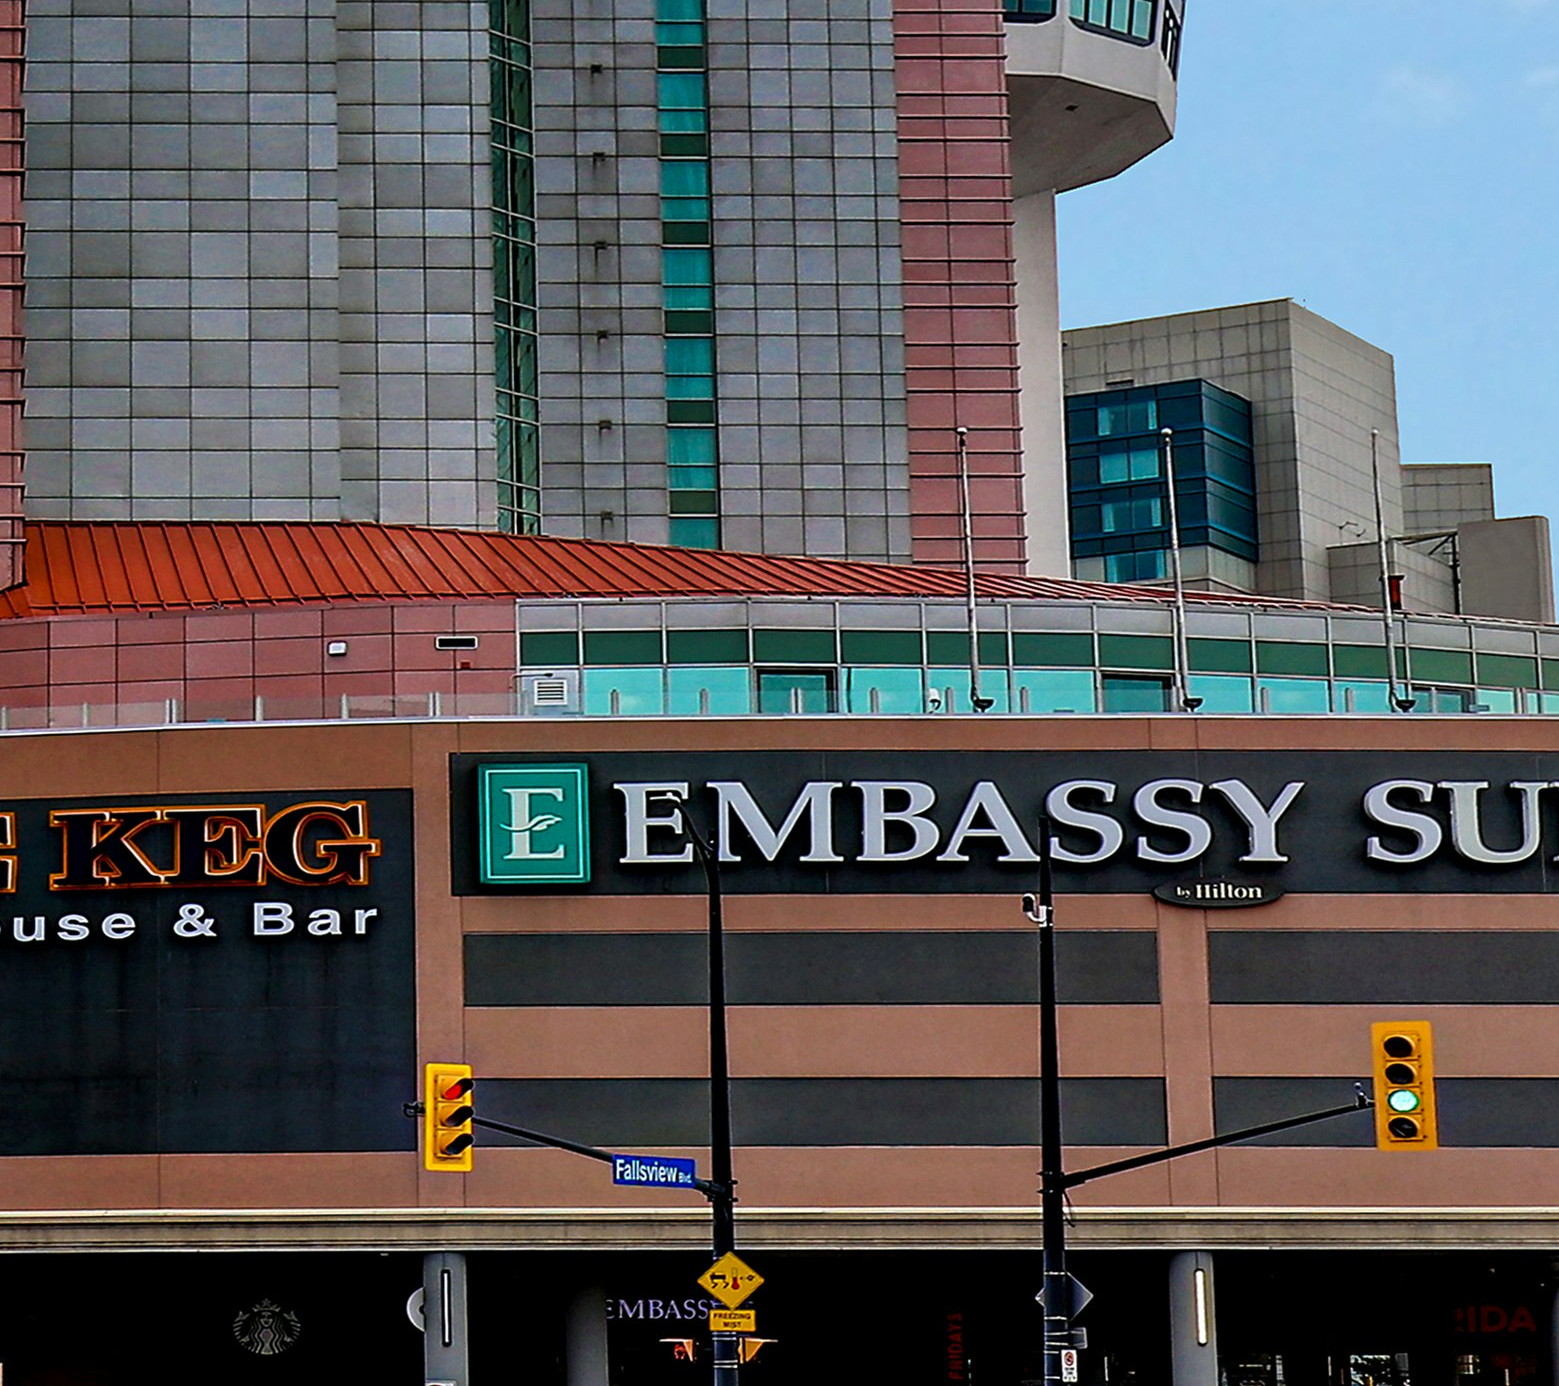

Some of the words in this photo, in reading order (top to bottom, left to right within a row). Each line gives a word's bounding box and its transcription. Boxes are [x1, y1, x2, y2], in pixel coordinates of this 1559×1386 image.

[613, 778, 1306, 864] EMBASSY
[48, 800, 381, 892] KEG
[1176, 886, 1191, 899] by
[1196, 882, 1263, 899] Hilton
[172, 903, 217, 938] &
[252, 901, 378, 936] Bar
[615, 1159, 677, 1183] Fallsview
[606, 1299, 724, 1320] EMBASS
[713, 1312, 751, 1320] FREEZING
